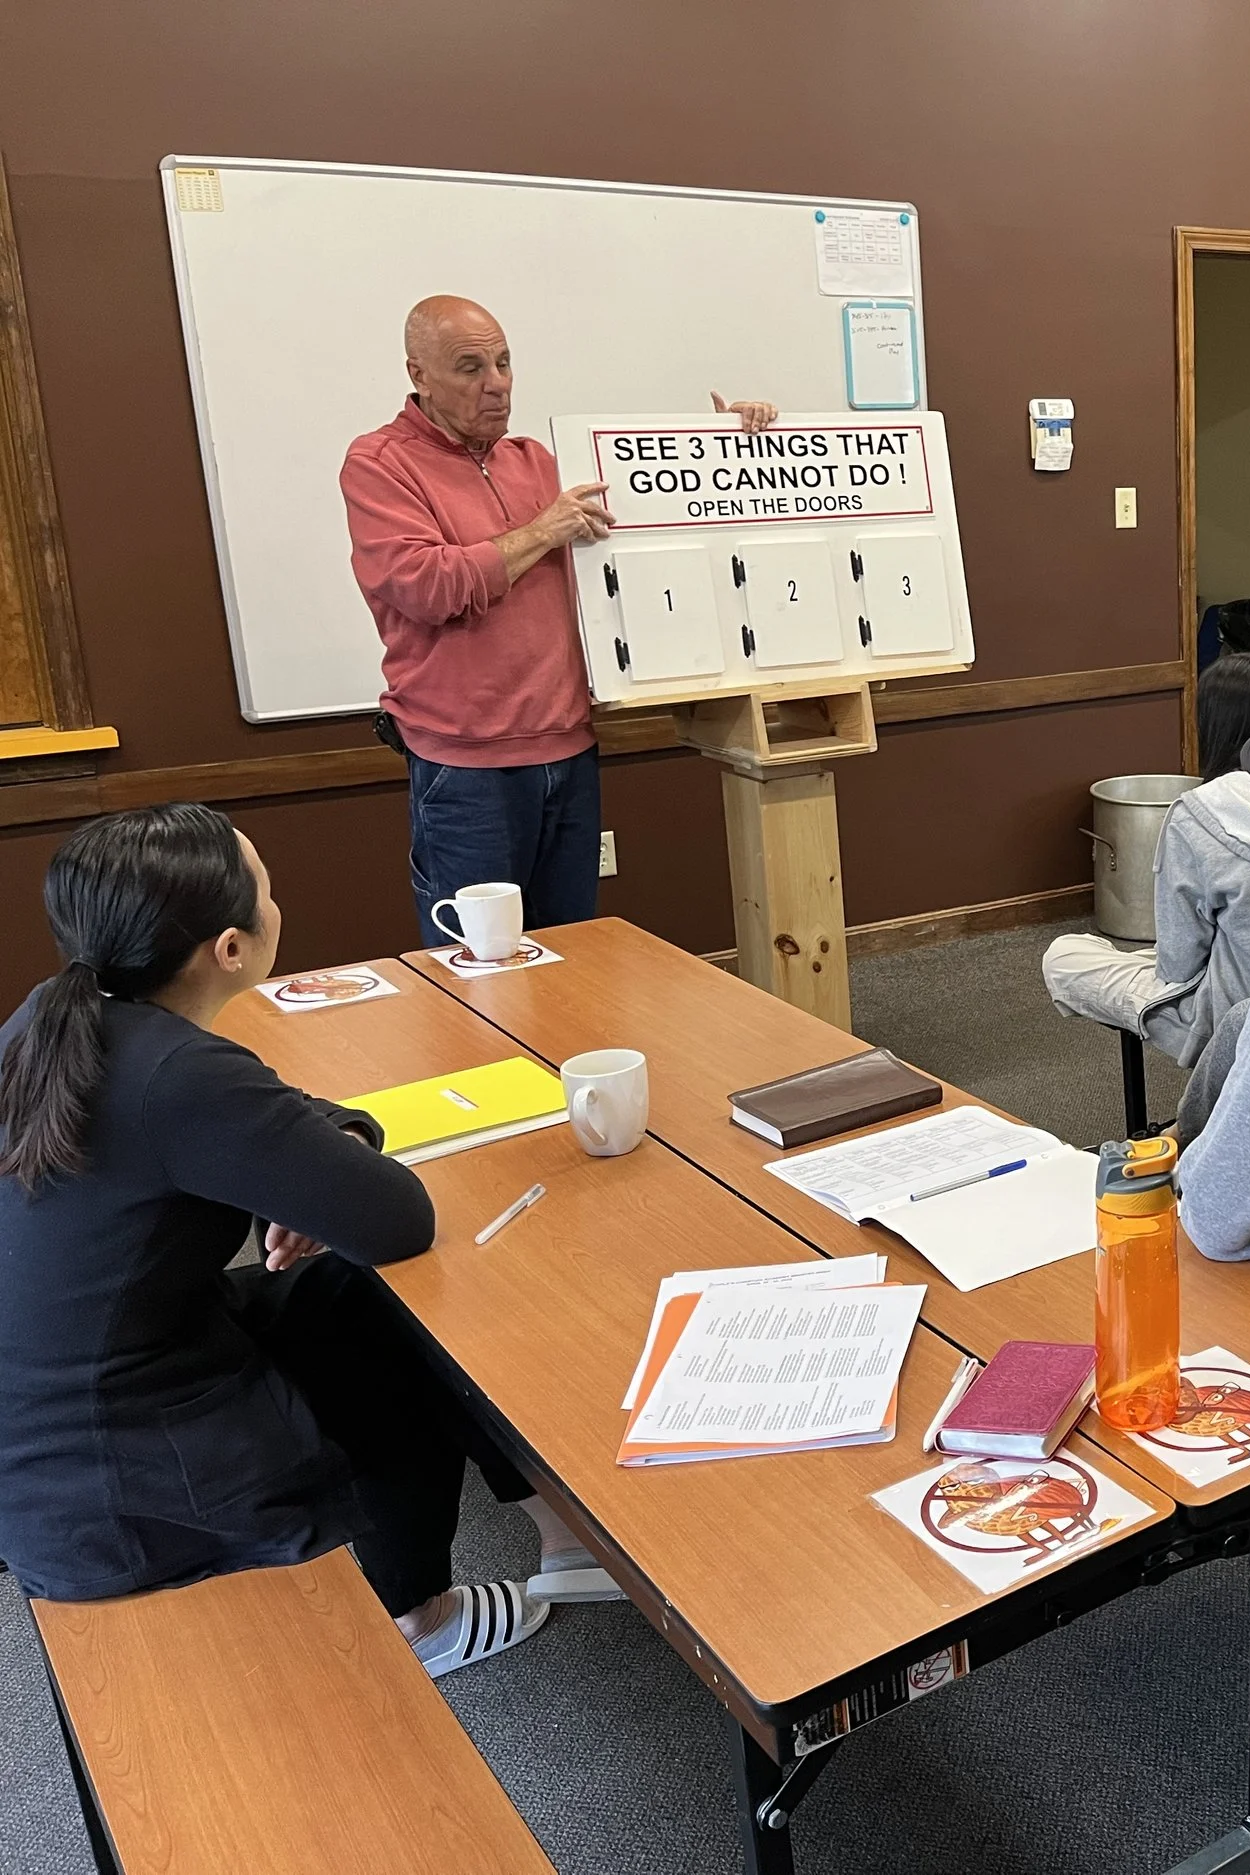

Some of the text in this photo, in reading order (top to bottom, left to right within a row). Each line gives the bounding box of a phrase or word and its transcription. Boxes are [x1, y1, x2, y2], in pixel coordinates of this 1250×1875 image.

[614, 433, 909, 461] SEE 3 THINGS THAT
[629, 469, 701, 494] GOD
[712, 465, 839, 491] CANNOT
[848, 463, 890, 486] DO
[687, 495, 863, 517] OPEN THE DOORS
[787, 579, 799, 602] 2
[902, 575, 912, 597] 3
[663, 588, 673, 612] 1
